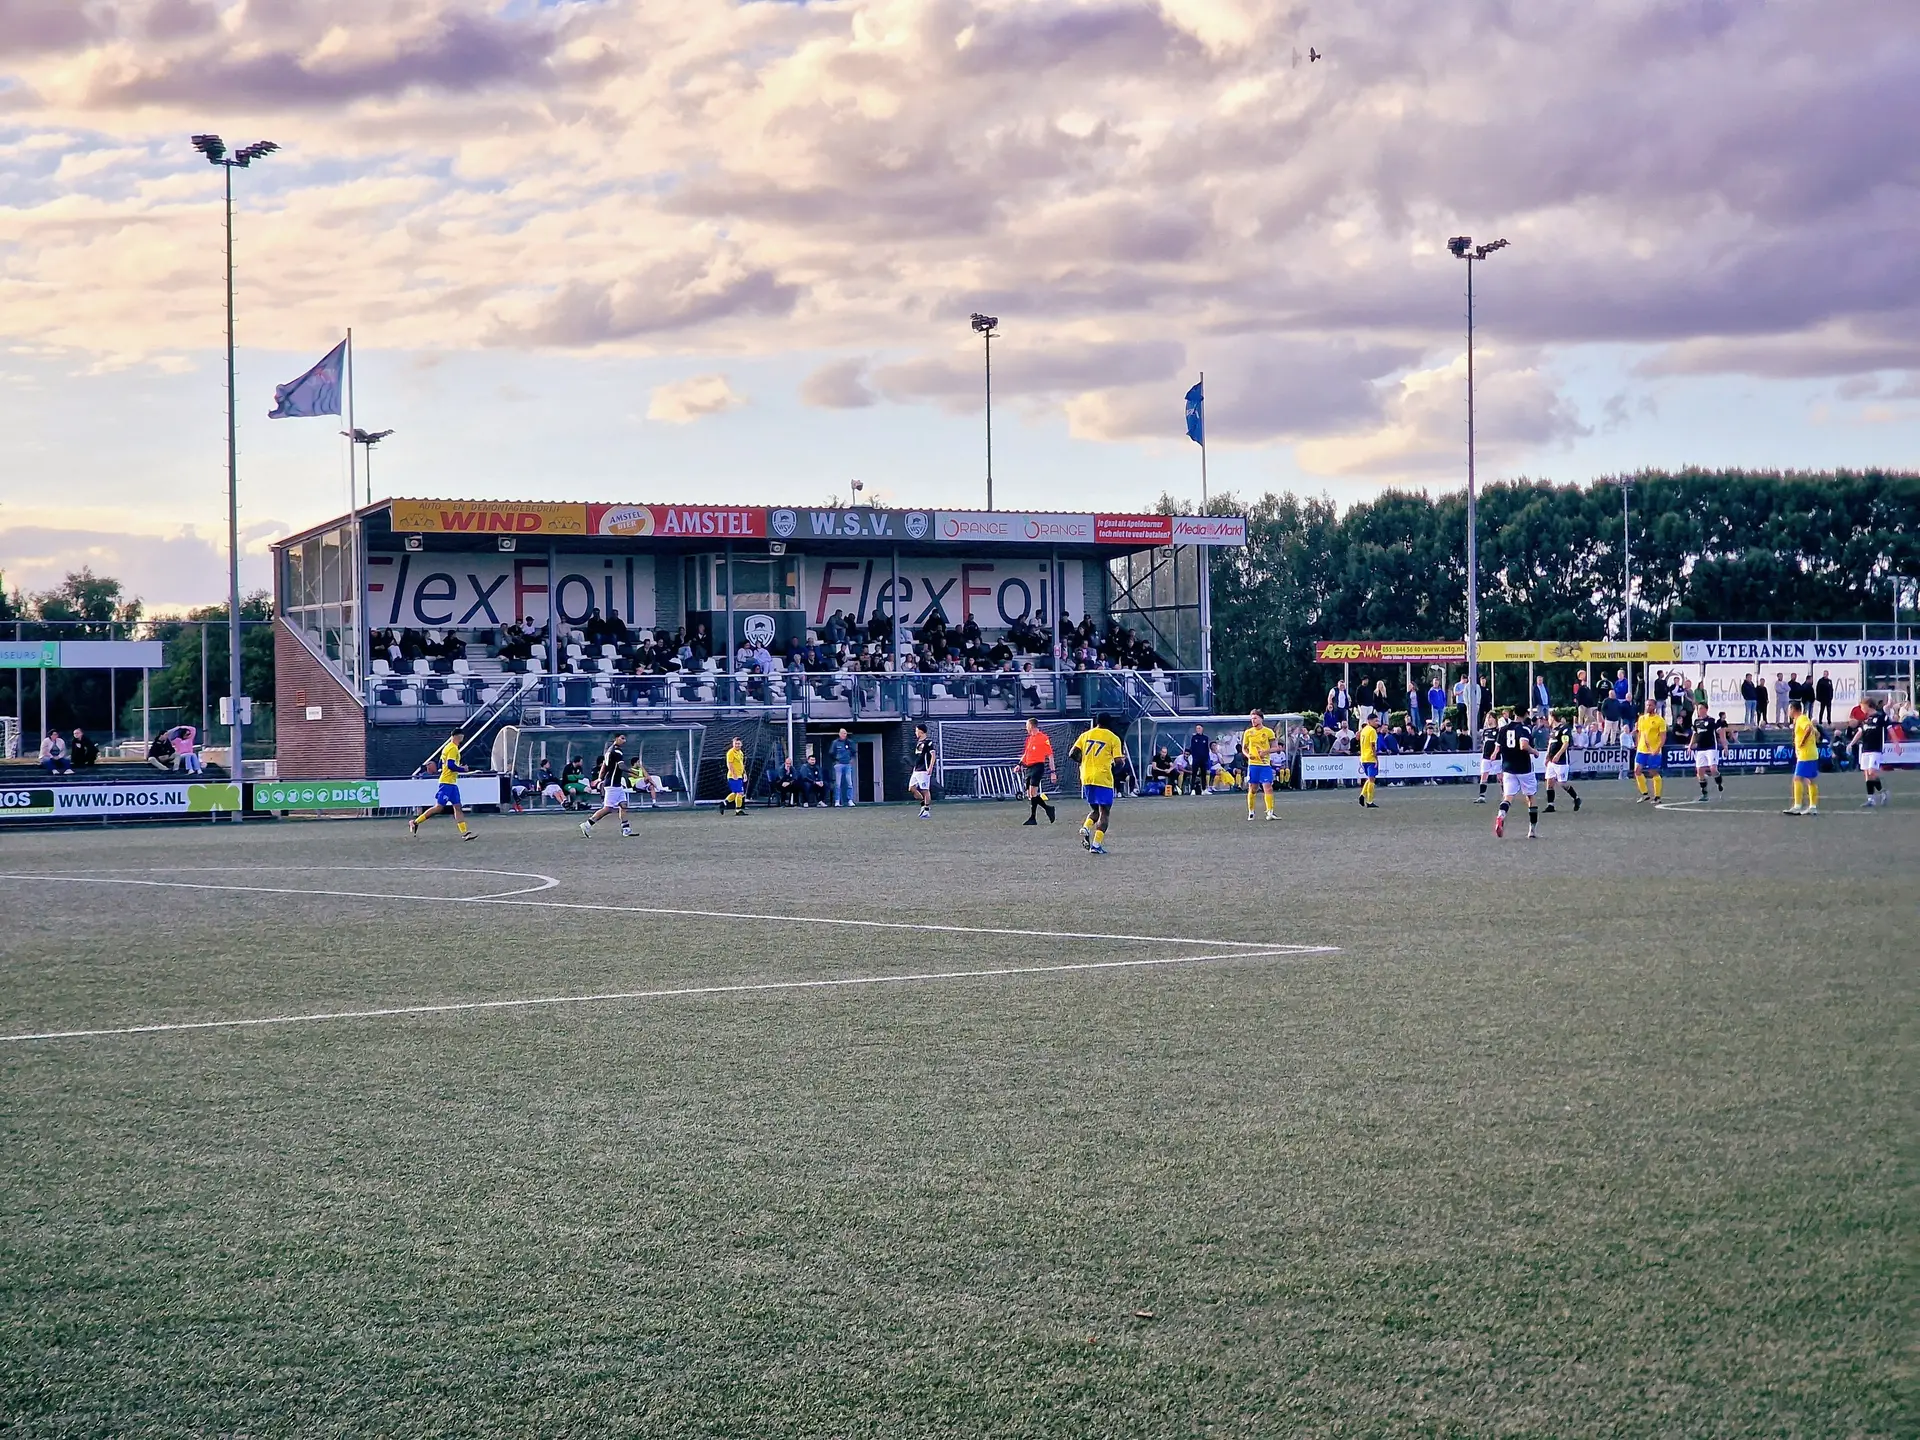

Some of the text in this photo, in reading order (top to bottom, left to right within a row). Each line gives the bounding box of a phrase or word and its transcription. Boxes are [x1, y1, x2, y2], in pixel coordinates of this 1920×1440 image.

[440, 511, 543, 532] WIND
[610, 511, 642, 524] AMSTEL
[664, 509, 753, 534] AMSTEL
[810, 512, 893, 535] W.S.V.
[1104, 520, 1118, 528] gaat
[1127, 520, 1164, 528] Apeldoorner
[617, 521, 637, 530] BIER
[777, 524, 792, 533] WSV
[944, 519, 1008, 537] ORANGE
[1024, 521, 1087, 538] ORANGE
[1174, 522, 1243, 536] Media Markt
[815, 559, 1065, 625] FlexFoil
[1321, 644, 1361, 659] ACTG
[1422, 645, 1464, 653] www.actg.nl
[1705, 643, 1805, 658] VETERANEN
[1814, 643, 1848, 657] WSV
[1855, 645, 1919, 657] 1995-2011
[1711, 679, 1742, 692] FLAI
[1835, 678, 1856, 692] AIR
[1506, 730, 1516, 748] 8
[1085, 739, 1107, 757] 77
[1739, 748, 1758, 760] MET
[1760, 748, 1771, 759] DE
[1773, 748, 1794, 759] WSV
[1584, 750, 1629, 763] DOOPER
[1305, 763, 1344, 771] be insured
[1394, 761, 1431, 769] be insured
[58, 791, 186, 808] WWW.DROS.NL
